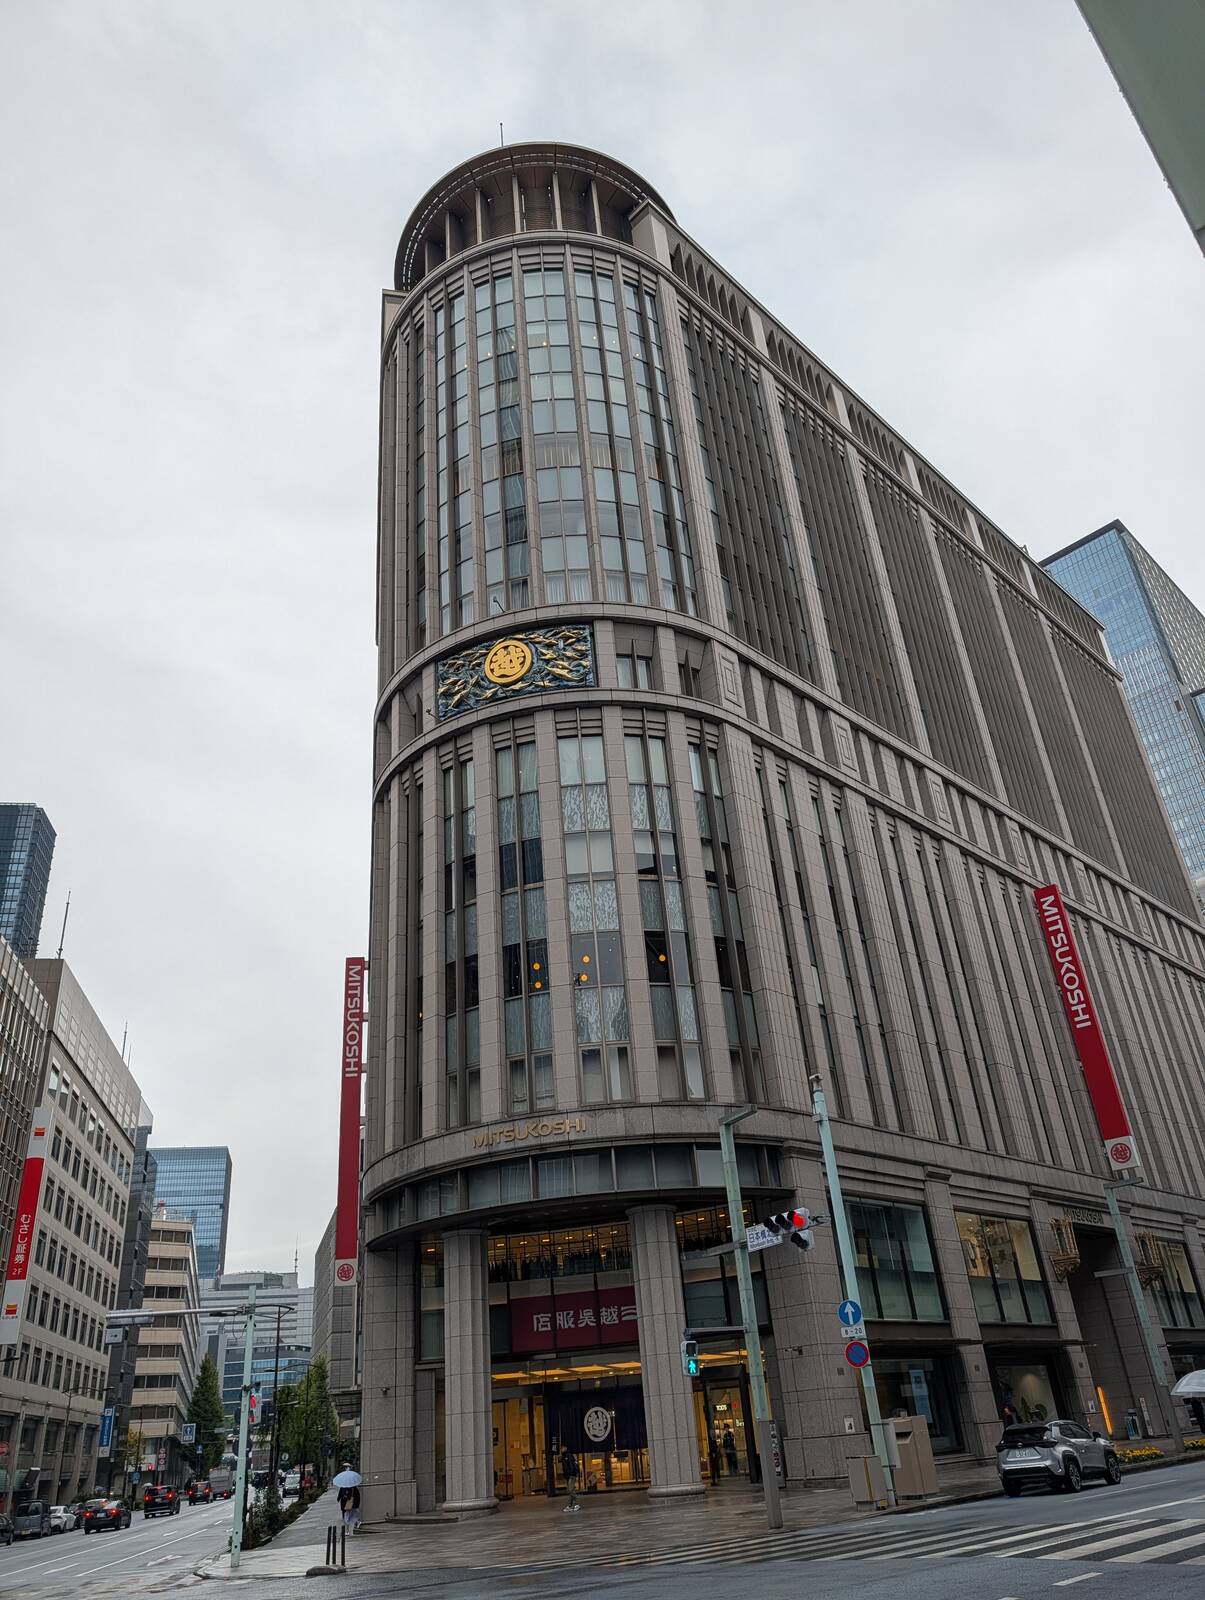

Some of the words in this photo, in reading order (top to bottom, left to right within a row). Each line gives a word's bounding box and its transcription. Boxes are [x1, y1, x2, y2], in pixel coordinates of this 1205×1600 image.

[1040, 895, 1092, 1029] MITSUKOSHI
[344, 965, 362, 1078] MITSUKOSHI
[472, 1117, 587, 1149] MITSUKOSHI
[12, 1268, 23, 1276] 2F
